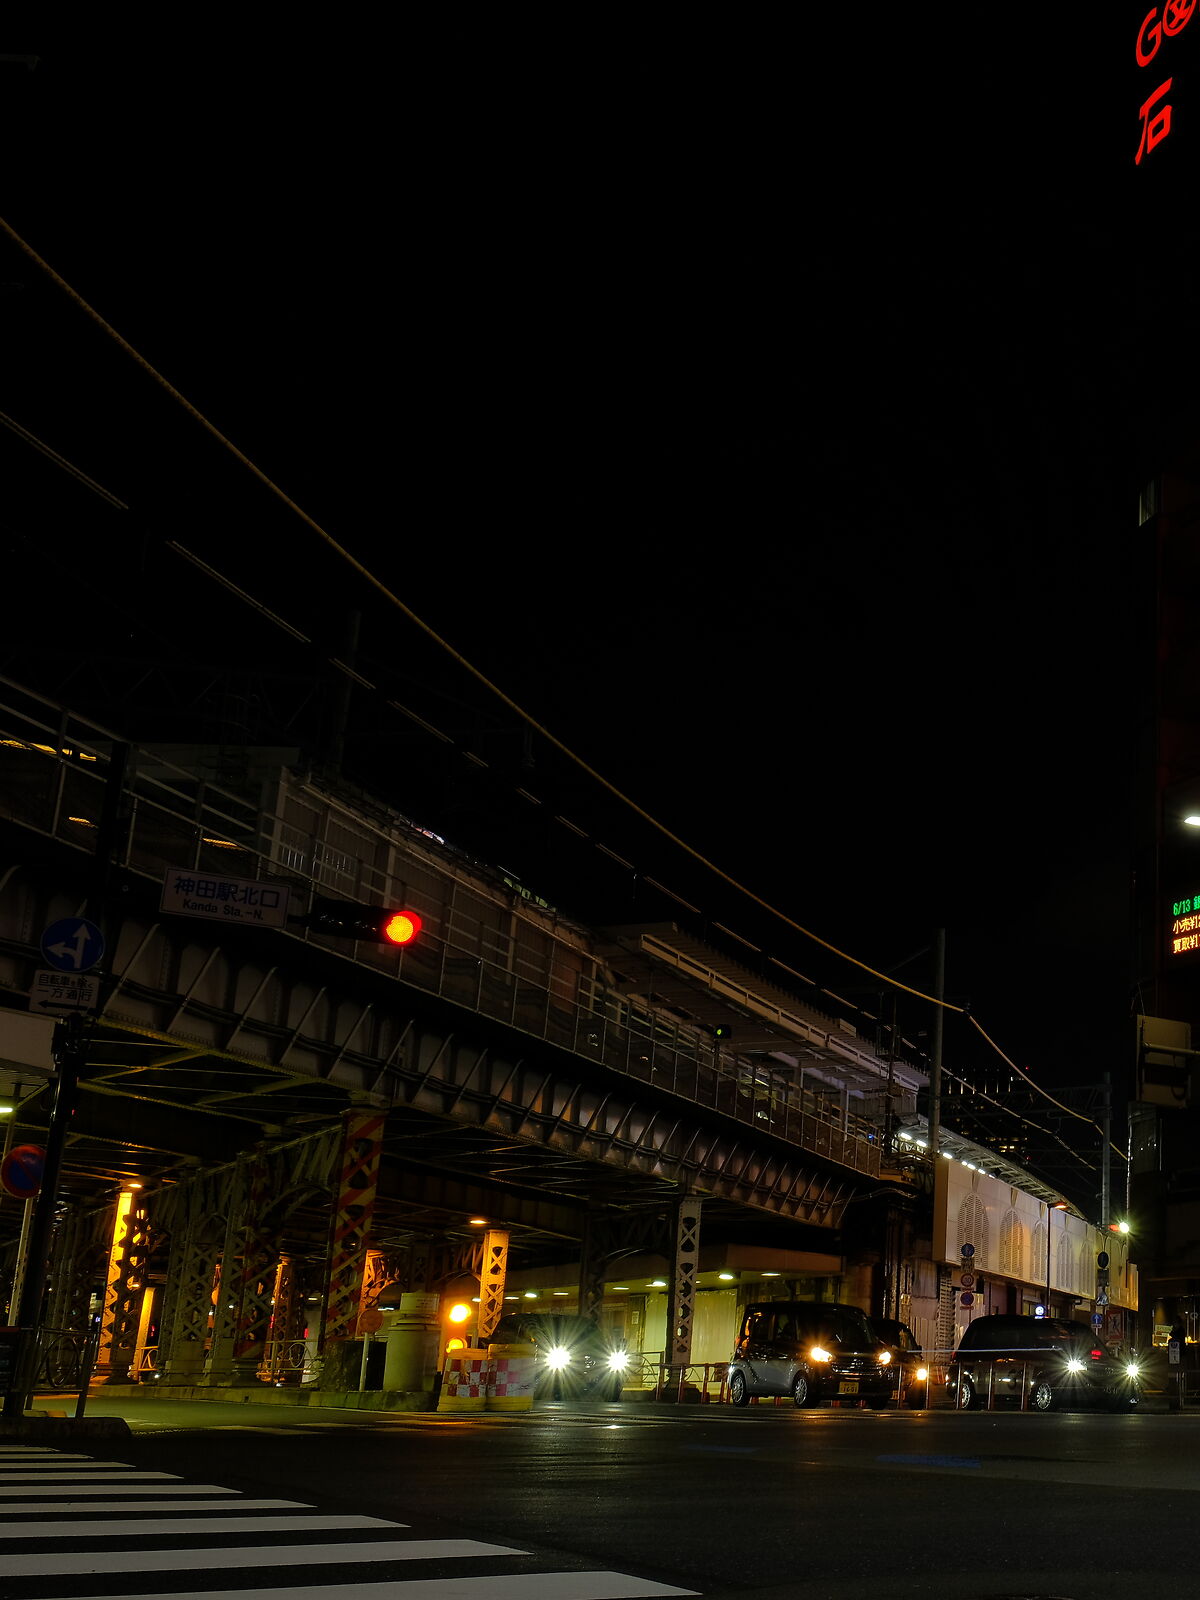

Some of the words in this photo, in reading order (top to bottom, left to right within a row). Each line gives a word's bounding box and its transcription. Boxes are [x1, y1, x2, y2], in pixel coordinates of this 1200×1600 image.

[175, 878, 280, 908] 神田駅北口
[183, 898, 218, 913] Kanda
[1173, 898, 1191, 916] 6/13
